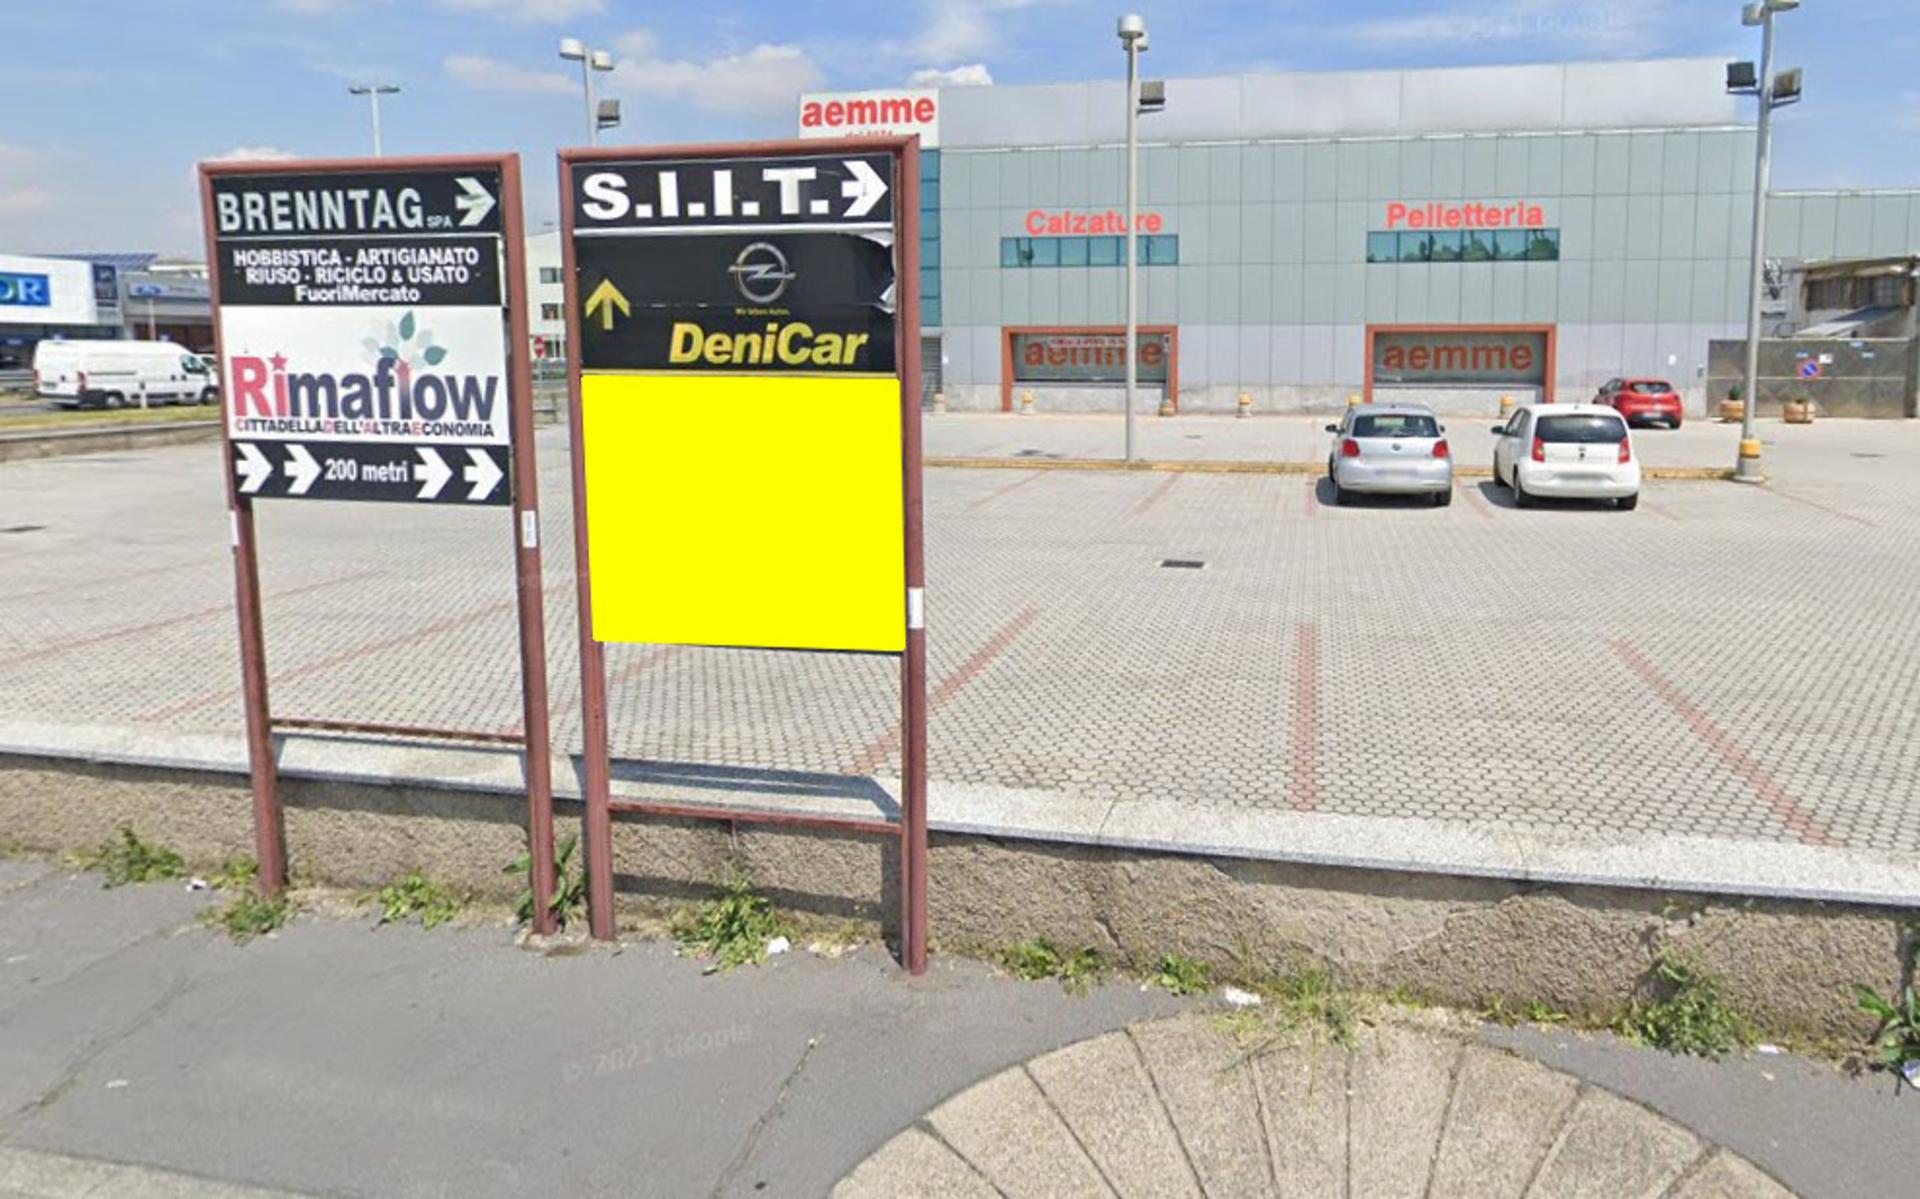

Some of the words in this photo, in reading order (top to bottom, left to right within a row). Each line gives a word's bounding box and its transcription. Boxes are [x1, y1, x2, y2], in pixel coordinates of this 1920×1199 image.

[802, 98, 935, 127] aemme
[582, 166, 830, 220] S.I.I.T.
[217, 188, 423, 232] BRENNTAG
[1025, 210, 1162, 235] Calzature
[1386, 202, 1543, 228] Pelletteria
[233, 249, 342, 266] HOBBISTICA
[355, 248, 479, 265] ARTIGIANATO
[246, 267, 300, 284] RIUSO
[315, 267, 387, 284] RICICLO
[391, 270, 403, 283] &
[407, 266, 469, 283] USATO
[295, 285, 421, 302] FuoriMercato
[668, 322, 869, 365] DeniCar
[1383, 343, 1533, 370] aemme
[231, 354, 498, 421] Rimaflow
[324, 459, 357, 481] 200
[362, 461, 409, 482] metri
